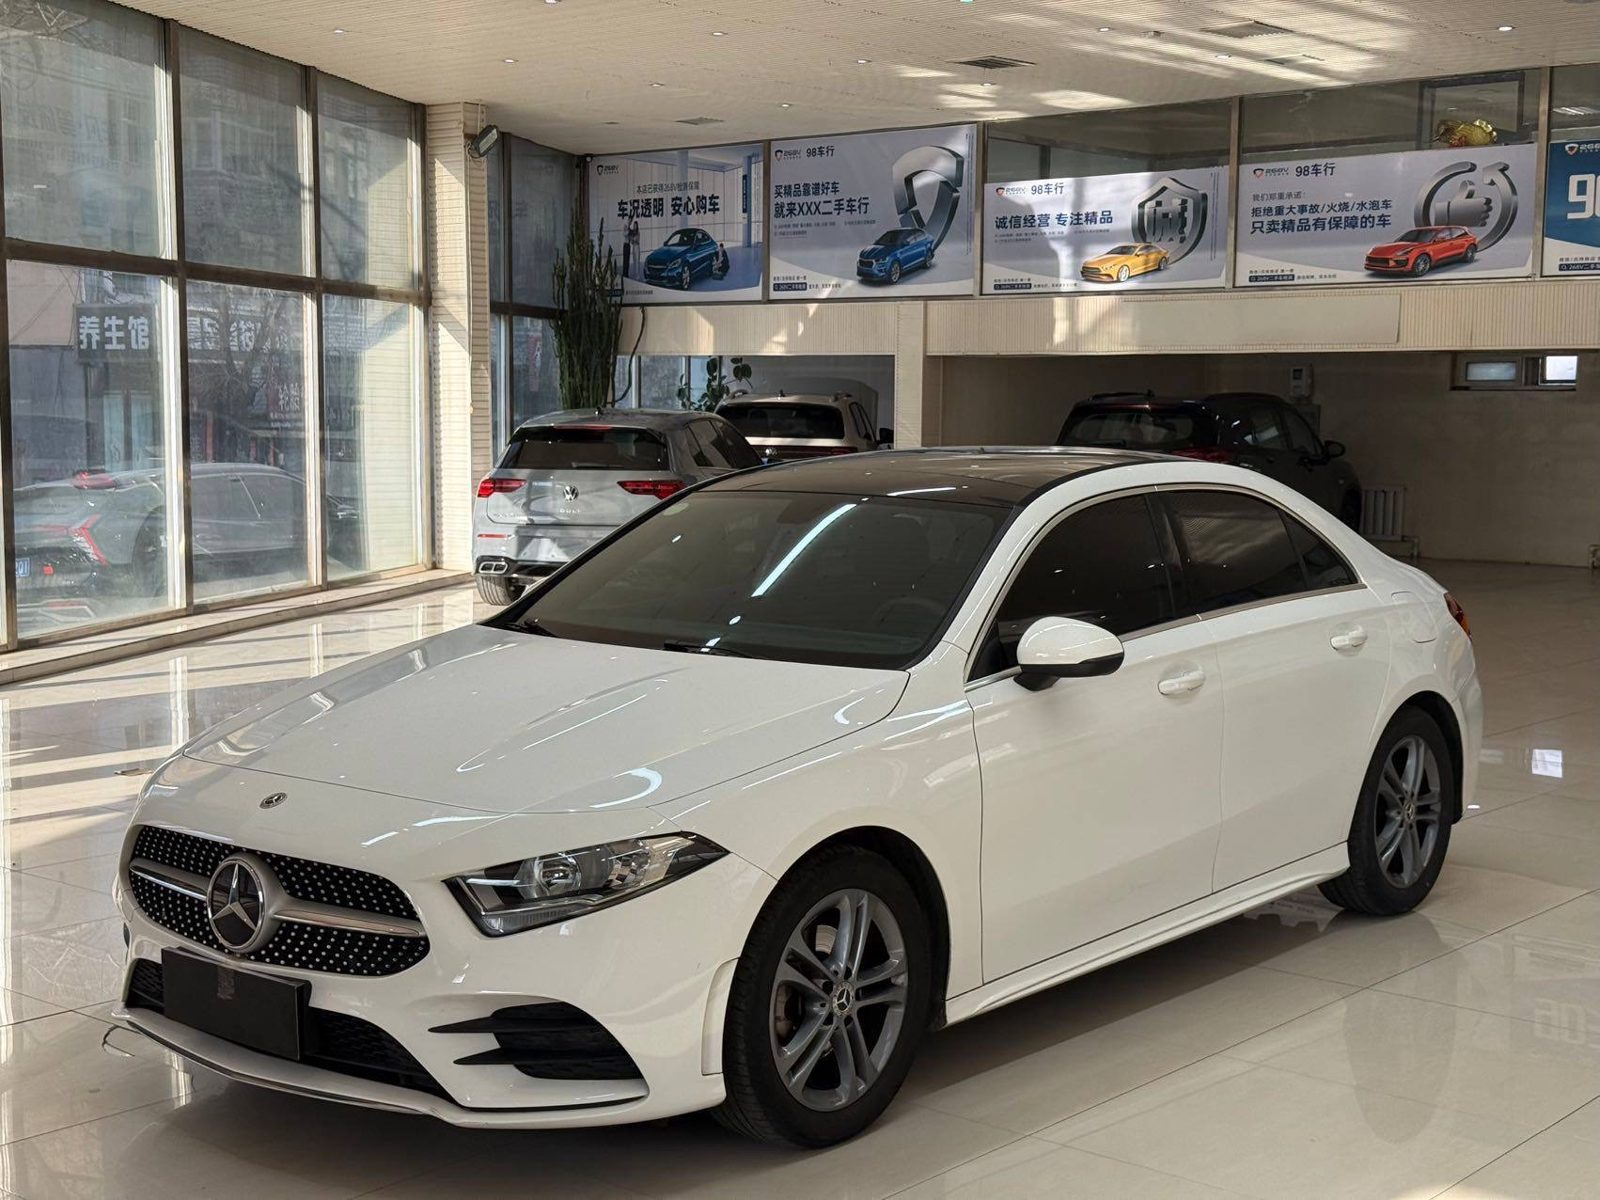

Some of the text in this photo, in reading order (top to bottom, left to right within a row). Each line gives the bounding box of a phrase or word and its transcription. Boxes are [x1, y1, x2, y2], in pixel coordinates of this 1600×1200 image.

[806, 146, 835, 157] 98车行
[1295, 162, 1335, 177] 98车行
[774, 181, 840, 199] 买精品靠谱好车
[1031, 182, 1064, 195] 98车行
[1567, 174, 1600, 220] 9
[617, 194, 720, 219] 车况透明 安心购车
[774, 196, 869, 219] 就来XXX二手车行
[1251, 199, 1393, 218] 拒绝重大事故/火烧/水泡车
[995, 210, 1113, 229] 诚信经营 专注精品
[1250, 213, 1392, 235] 只卖精品有保障的车
[79, 315, 149, 350] 养生馆
